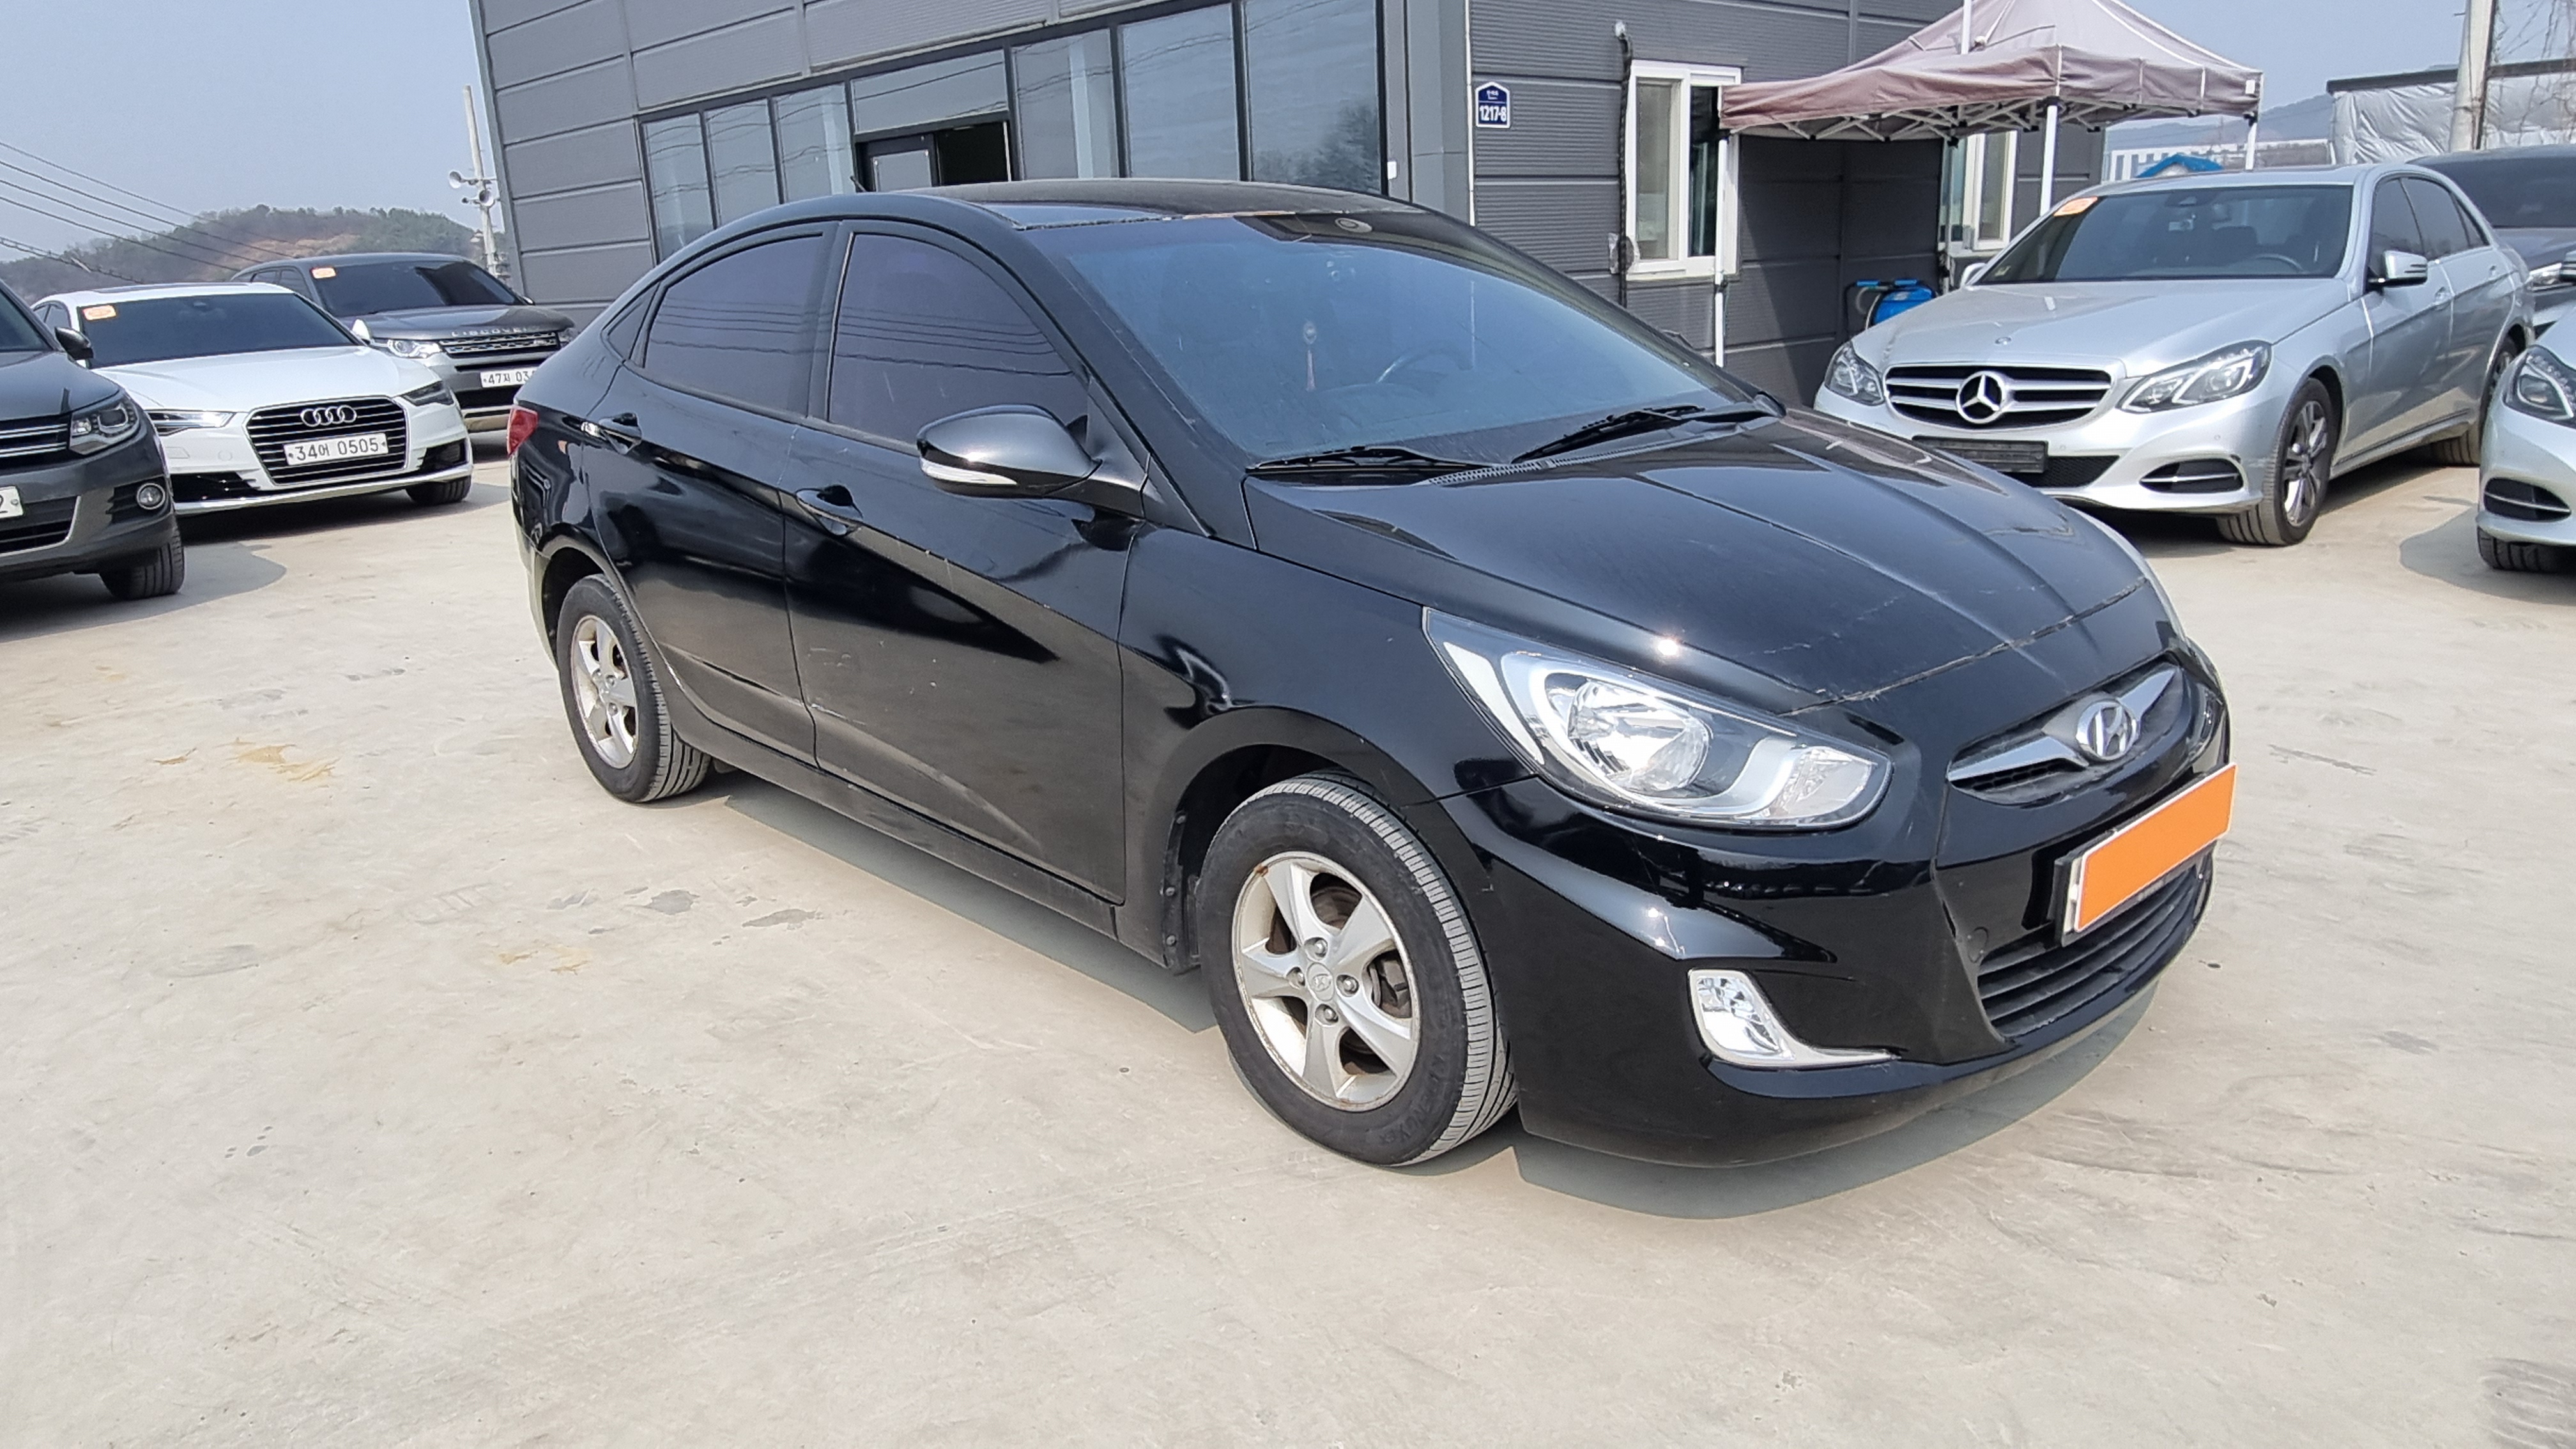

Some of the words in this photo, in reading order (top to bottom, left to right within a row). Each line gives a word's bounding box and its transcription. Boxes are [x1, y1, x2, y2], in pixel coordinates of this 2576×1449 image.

[1479, 105, 1506, 122] 1217-8
[515, 370, 535, 383] 03
[295, 443, 330, 461] 34어
[337, 438, 379, 456] 0505
